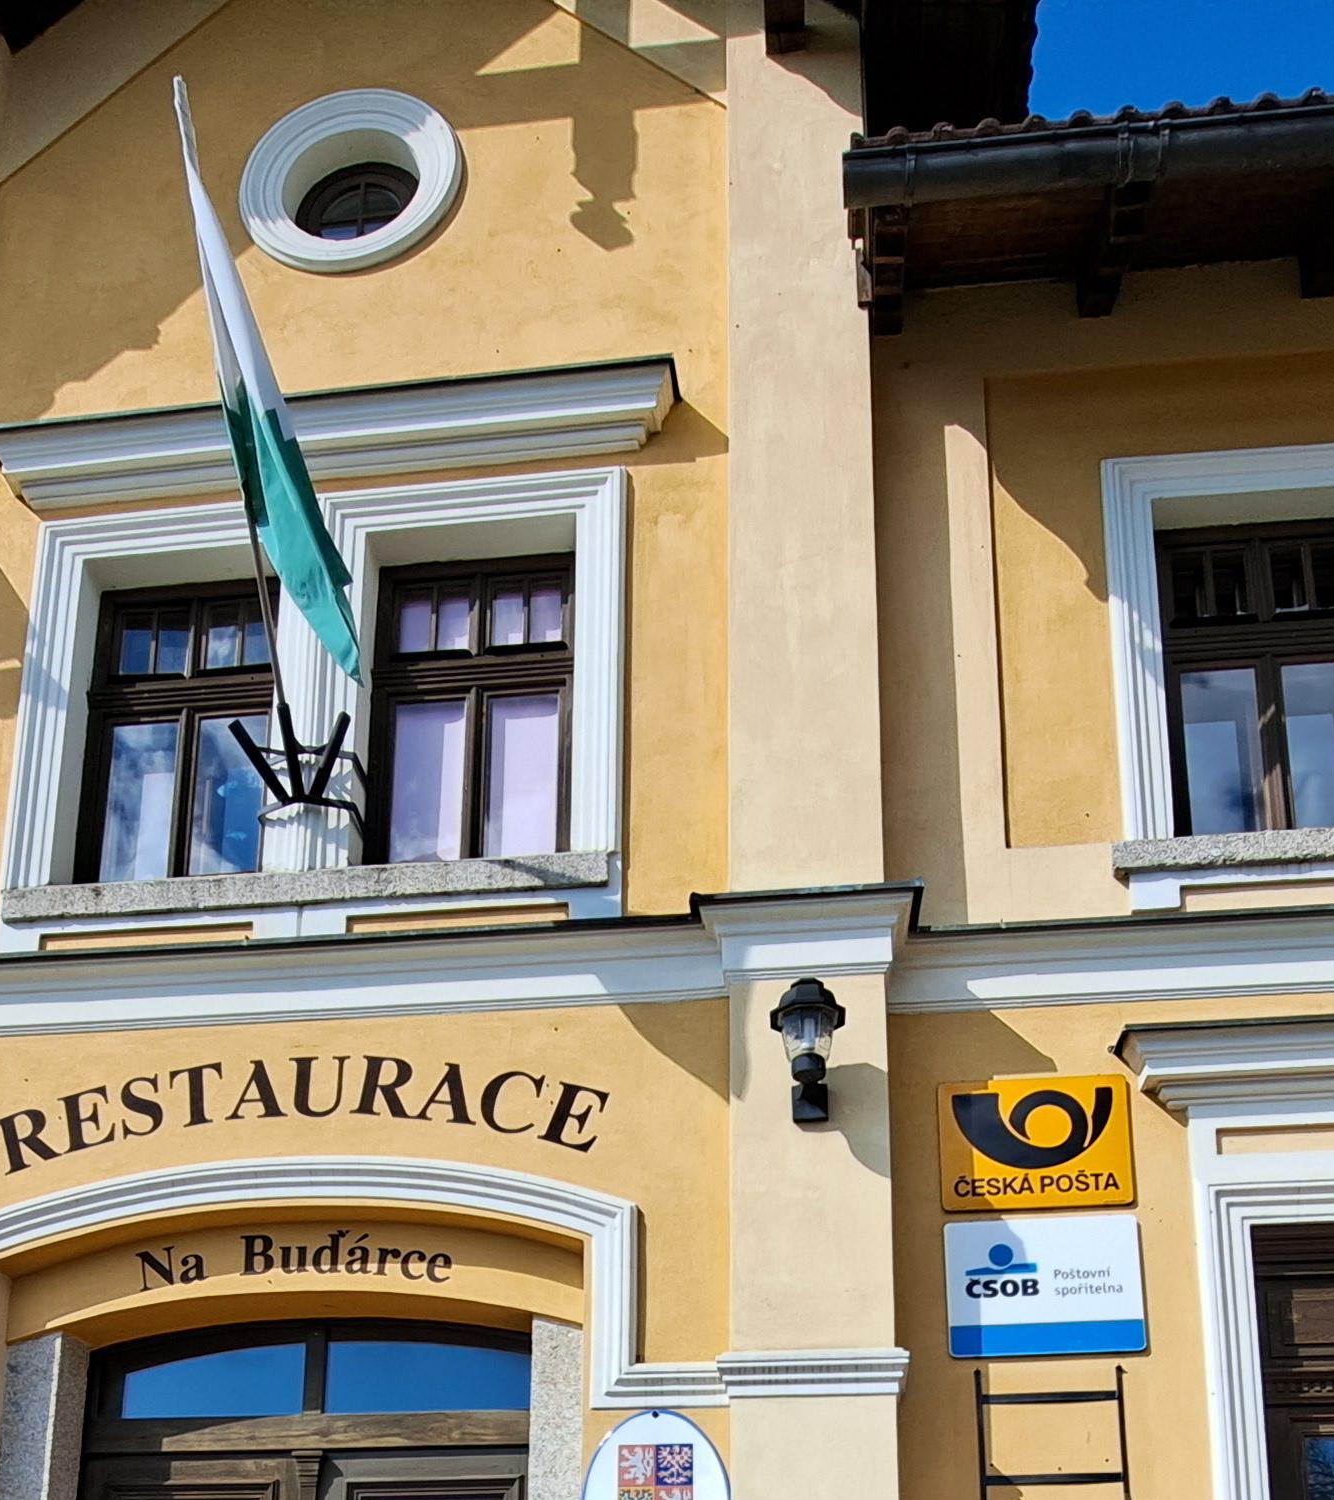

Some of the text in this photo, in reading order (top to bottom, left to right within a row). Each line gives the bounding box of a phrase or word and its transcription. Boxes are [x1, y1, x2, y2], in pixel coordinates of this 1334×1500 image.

[954, 1169, 1120, 1198] ČESKÁ POŠTA
[135, 1229, 453, 1292] Na Buďárce
[1054, 1266, 1111, 1281] Poštovní
[965, 1278, 1040, 1298] ČSOB
[1054, 1282, 1123, 1297] spořitelna
